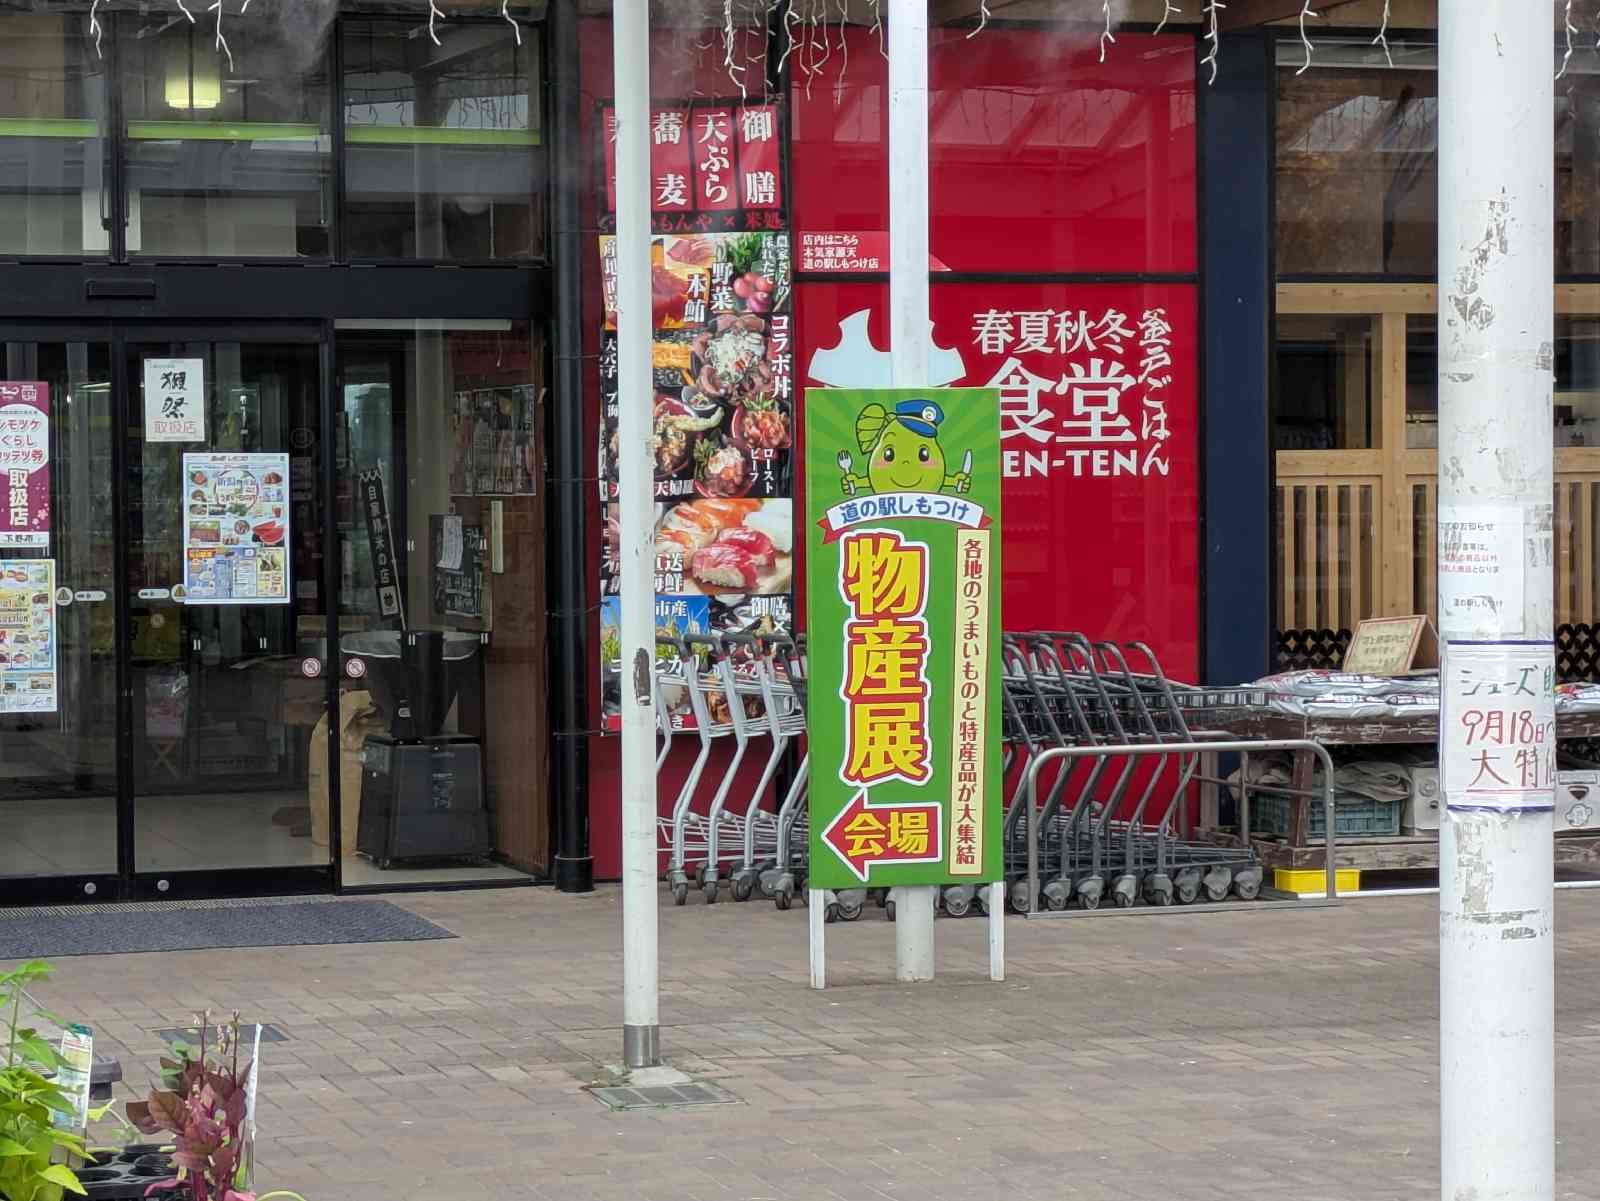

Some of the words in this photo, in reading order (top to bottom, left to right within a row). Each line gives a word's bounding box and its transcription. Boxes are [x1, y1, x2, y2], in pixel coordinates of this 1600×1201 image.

[652, 112, 689, 206] 蕎麦
[696, 111, 732, 204] 天ぷら
[741, 110, 776, 205] 御膳
[802, 234, 859, 246] 店内はこちら
[802, 258, 880, 270] 道の駅しもつけ店
[711, 262, 734, 311] 野菜
[770, 315, 792, 399] コラボ丼
[971, 308, 1136, 355] 春夏秋冬
[984, 358, 1138, 444] 食堂
[1137, 307, 1173, 478] 釜戸ごはん
[1, 433, 34, 446] くらし
[749, 447, 760, 483] ビーフ
[9, 468, 29, 526] 取扱店
[763, 447, 777, 494] ロースト
[840, 496, 971, 525] 道の駅しもつけ
[845, 533, 929, 782] 物産展
[955, 538, 984, 866] 各地のうまいものと特産品が大集結
[844, 810, 930, 858] 会場
